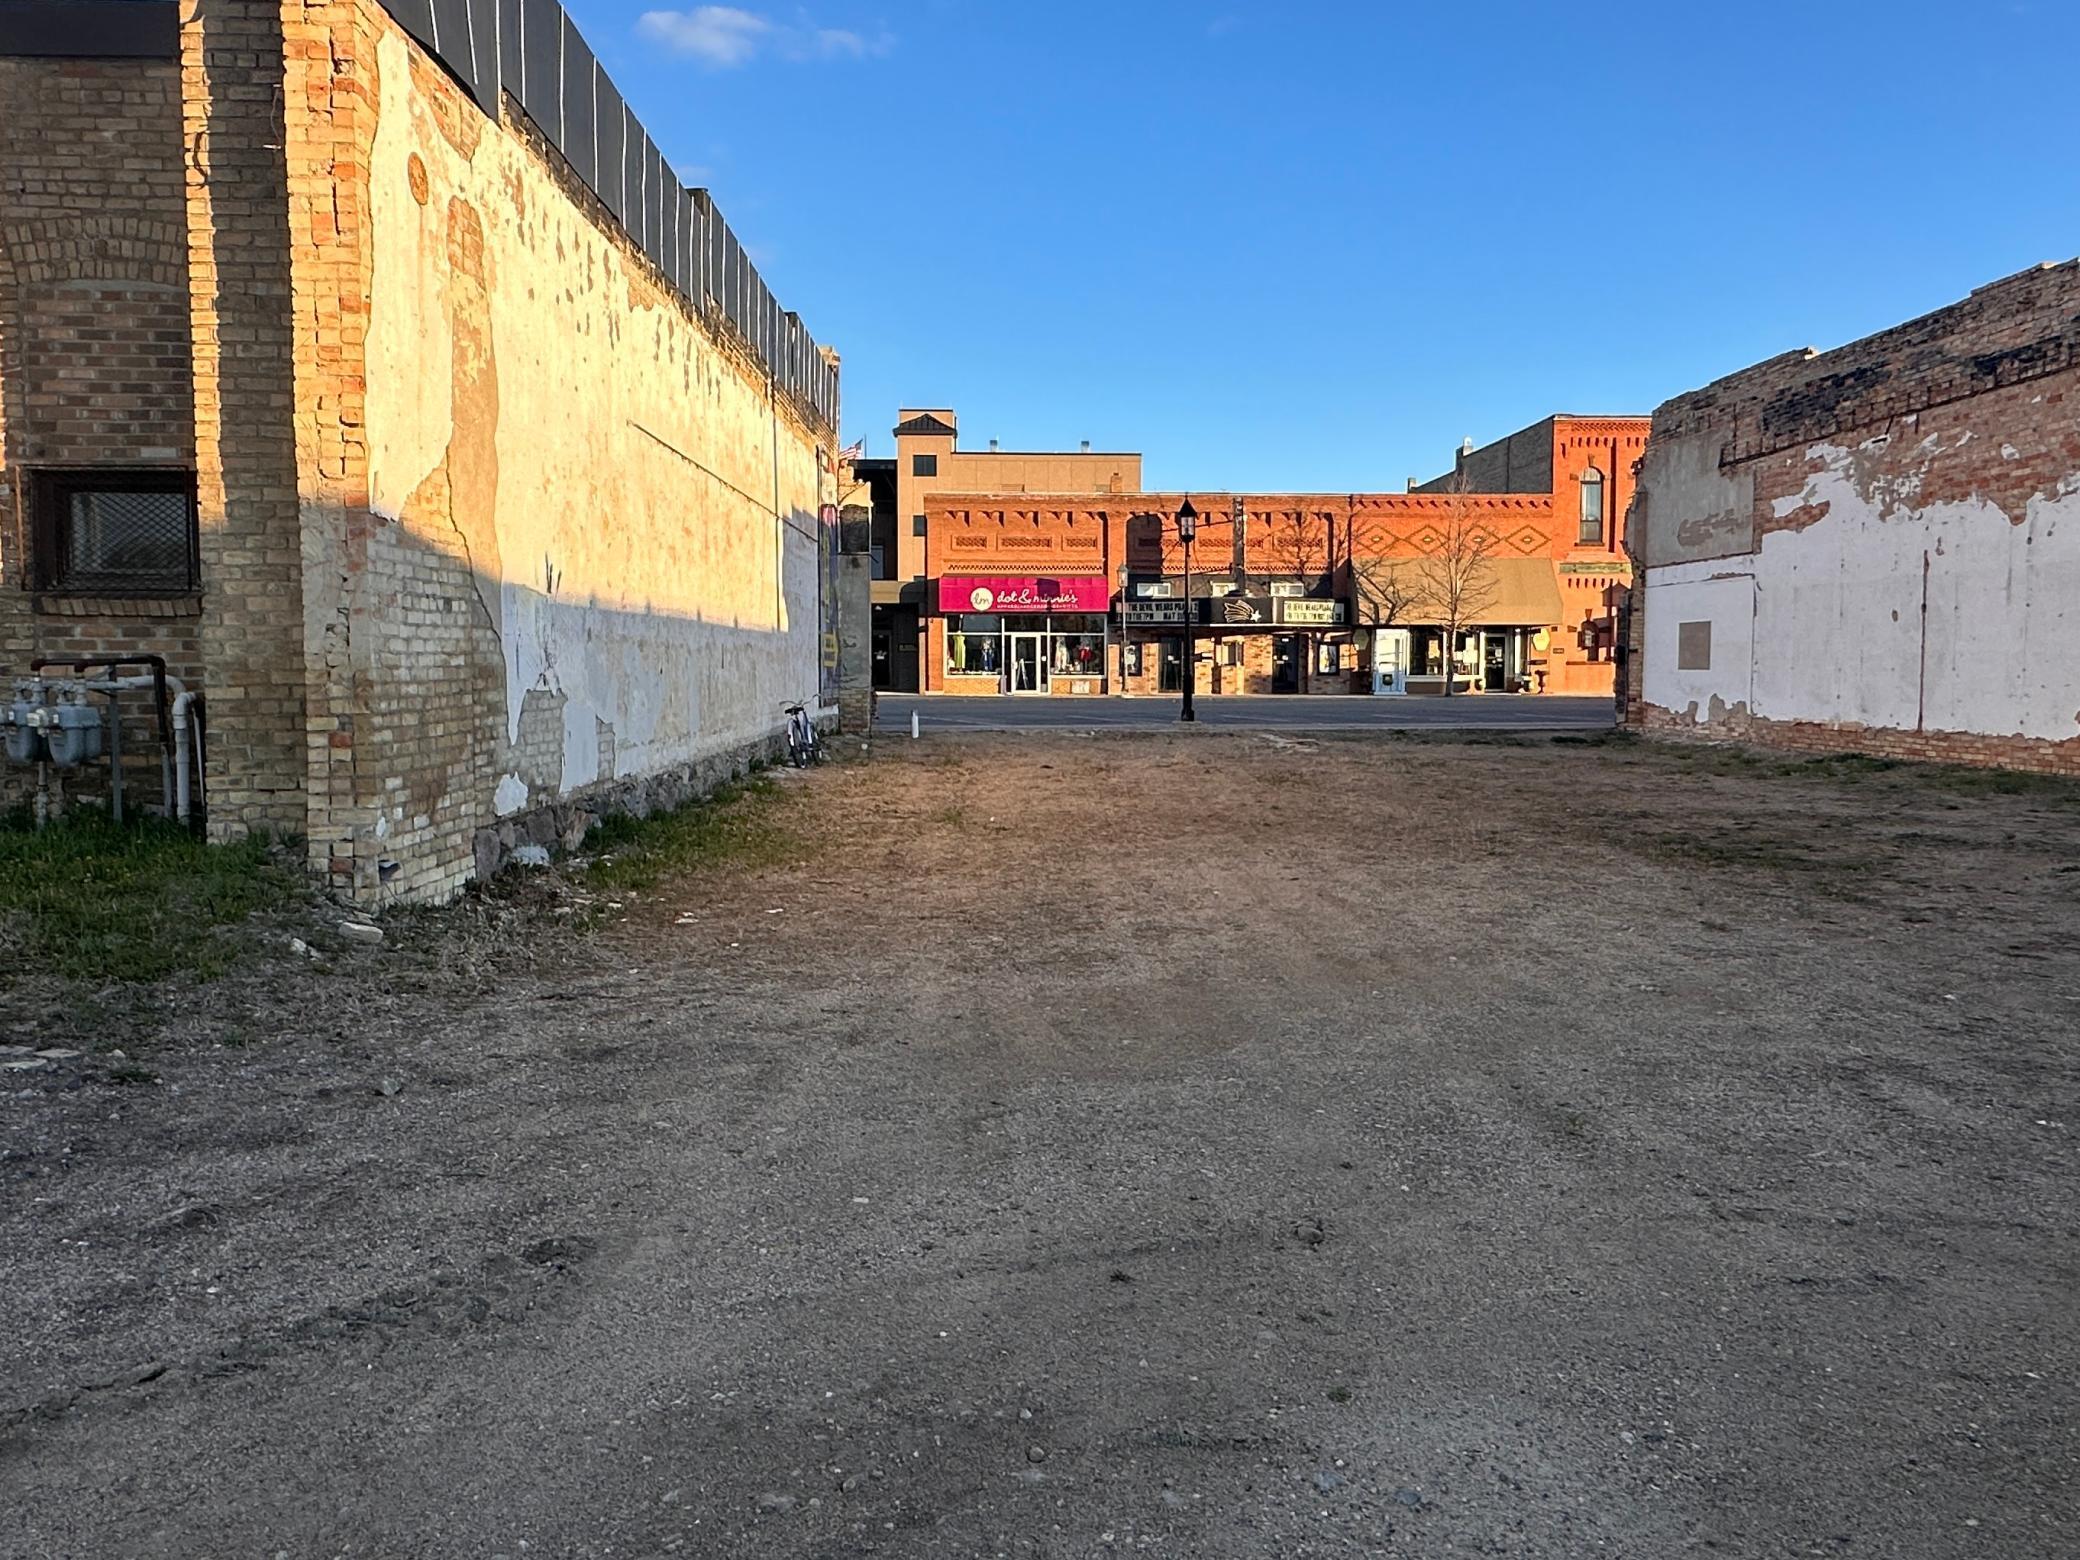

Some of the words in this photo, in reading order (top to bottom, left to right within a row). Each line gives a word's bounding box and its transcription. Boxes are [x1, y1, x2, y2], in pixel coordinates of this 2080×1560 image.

[997, 590, 1017, 603] dot
[1018, 589, 1031, 604] &
[1138, 603, 1153, 612] DEVIL
[1155, 603, 1174, 612] WEARS
